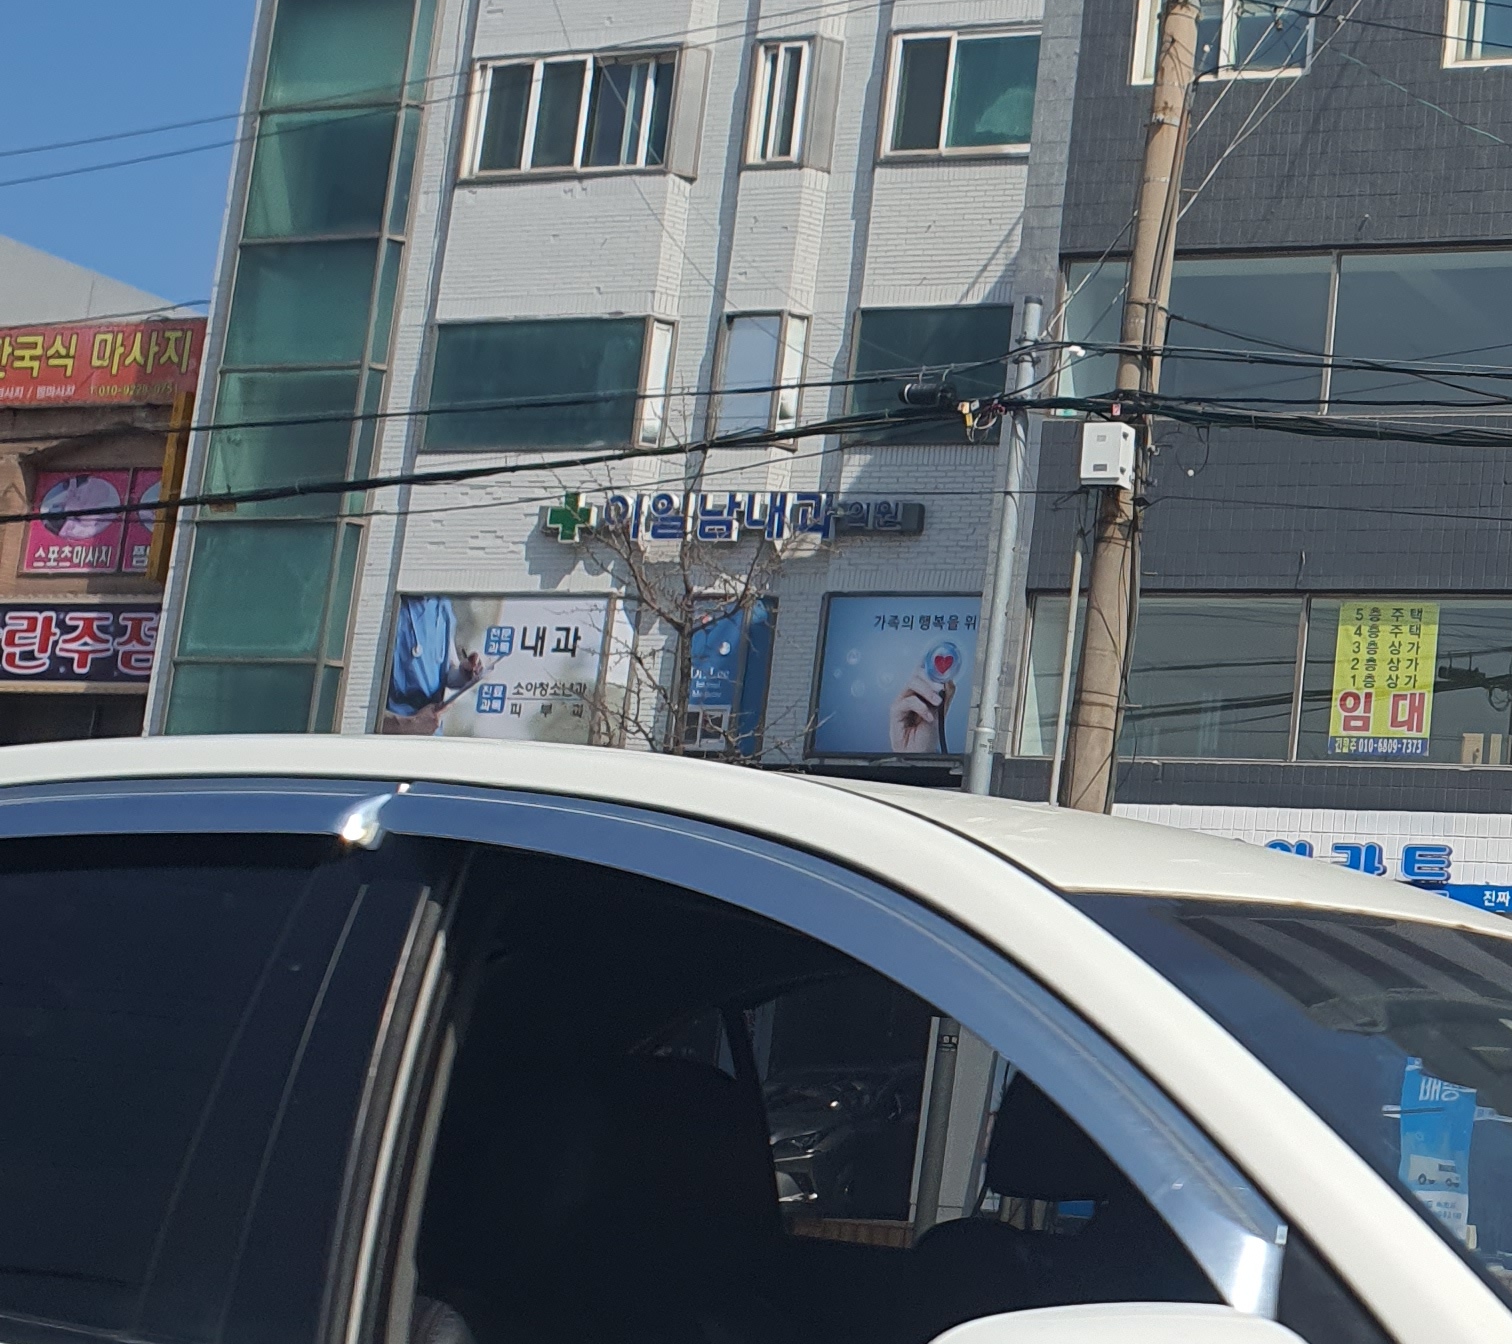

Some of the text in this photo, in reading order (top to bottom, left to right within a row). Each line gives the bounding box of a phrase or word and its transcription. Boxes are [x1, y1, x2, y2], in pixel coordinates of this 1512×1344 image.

[90, 330, 193, 376] 마사지
[32, 545, 112, 568] 스포츠마사지
[873, 614, 914, 631] 가족의
[918, 614, 959, 631] 행복을
[1390, 607, 1423, 622] 주택
[1389, 624, 1422, 639] 주택
[520, 625, 582, 658] 내과
[1388, 640, 1420, 655] 상가
[1387, 657, 1419, 672] 상가
[1386, 674, 1418, 689] 상가
[1338, 690, 1427, 734] 임대
[1482, 889, 1511, 907] 진짜
